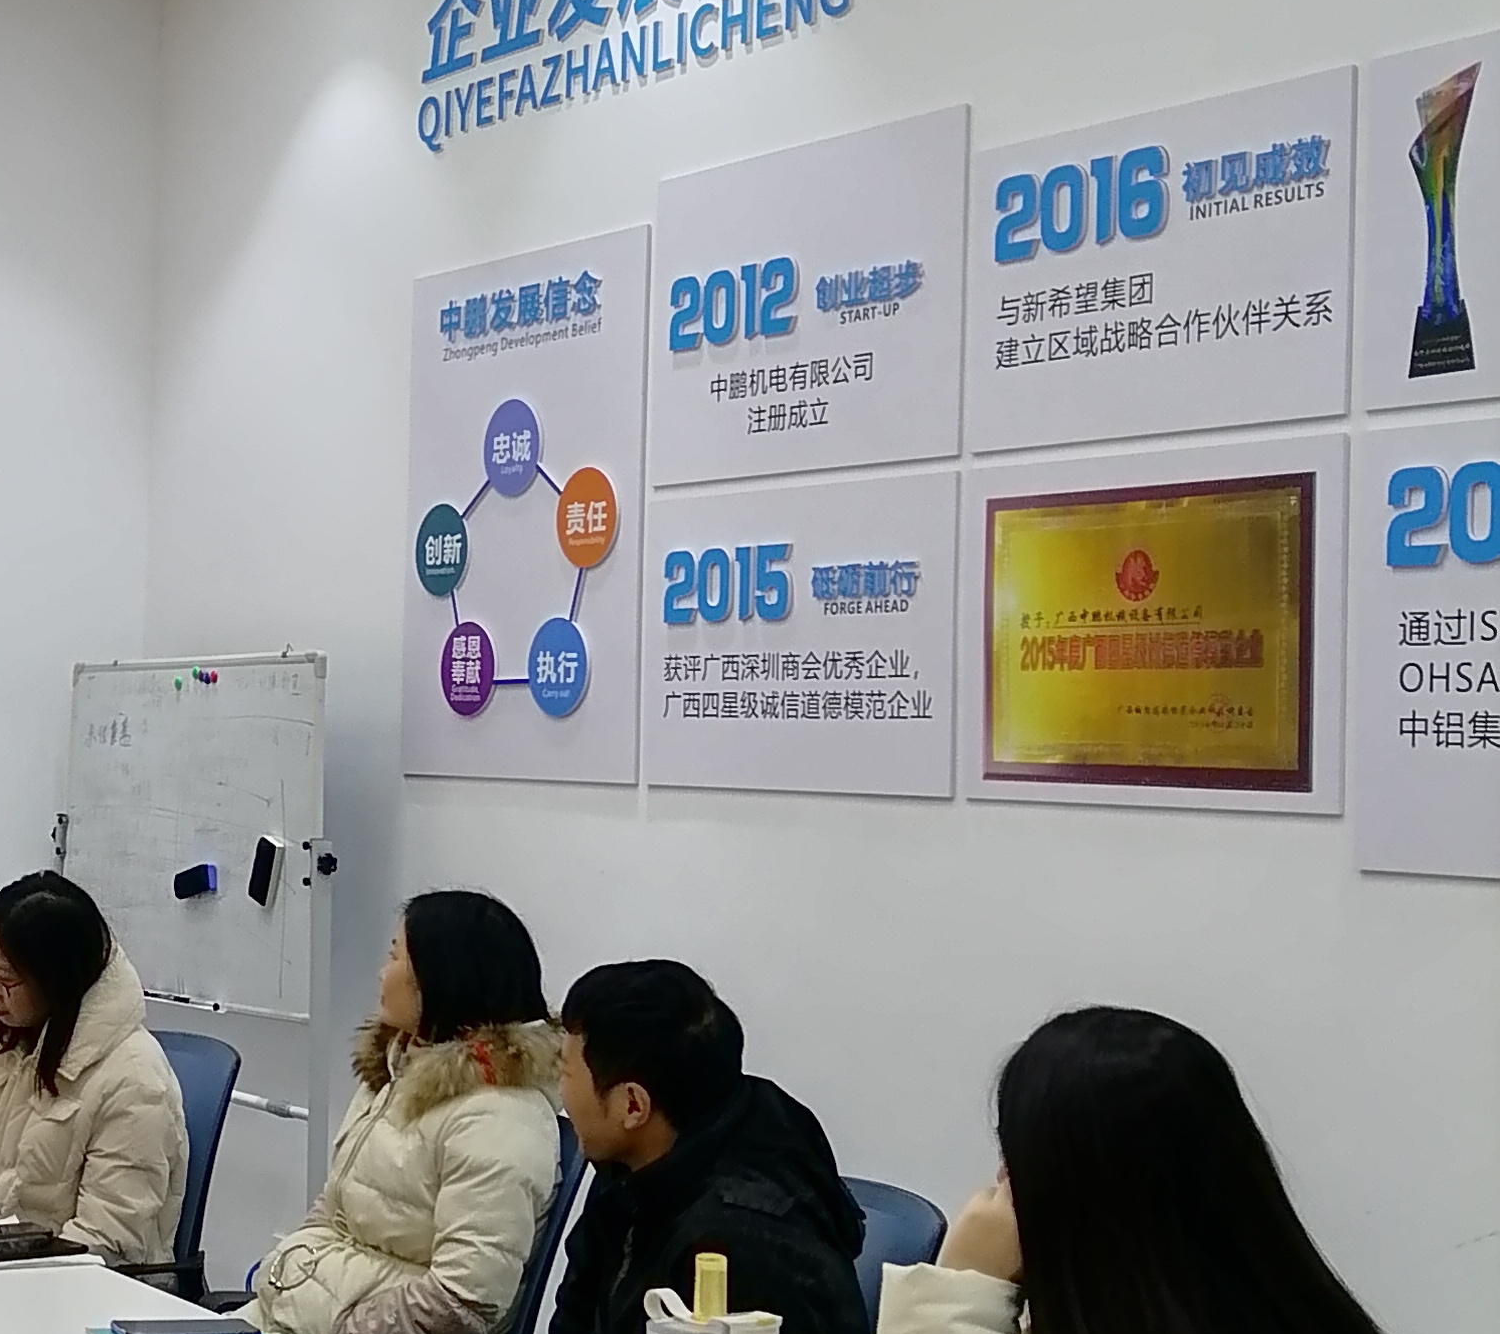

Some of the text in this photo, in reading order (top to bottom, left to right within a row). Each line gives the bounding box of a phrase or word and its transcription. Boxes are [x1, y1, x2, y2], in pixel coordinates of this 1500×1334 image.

[995, 146, 1170, 264] 2016
[1189, 181, 1325, 220] INITIAL RESULTS
[440, 270, 603, 342] 中鹏发展信念
[669, 257, 798, 352] 2012
[840, 302, 899, 325] START-UP
[997, 272, 1153, 326] 与新希望集团
[443, 318, 602, 362] Zhongpeng Development Belief
[996, 290, 1333, 369] 建立区域战略合作伙伴关系
[710, 352, 873, 402] 中鹏机电有限公司
[747, 398, 829, 434] 注册成立
[491, 430, 531, 464] 忠诚
[565, 501, 607, 535] 责任
[1386, 461, 1500, 567] 20
[425, 533, 462, 565] 创新
[663, 543, 793, 624] 2015
[823, 599, 909, 615] FORGE AHEAD
[537, 651, 578, 684] 执行
[664, 649, 918, 681] 获评广西深圳商会优秀企业，
[1399, 662, 1500, 693] OHSA
[663, 690, 933, 720] 广西四星级诚信道德模范企业
